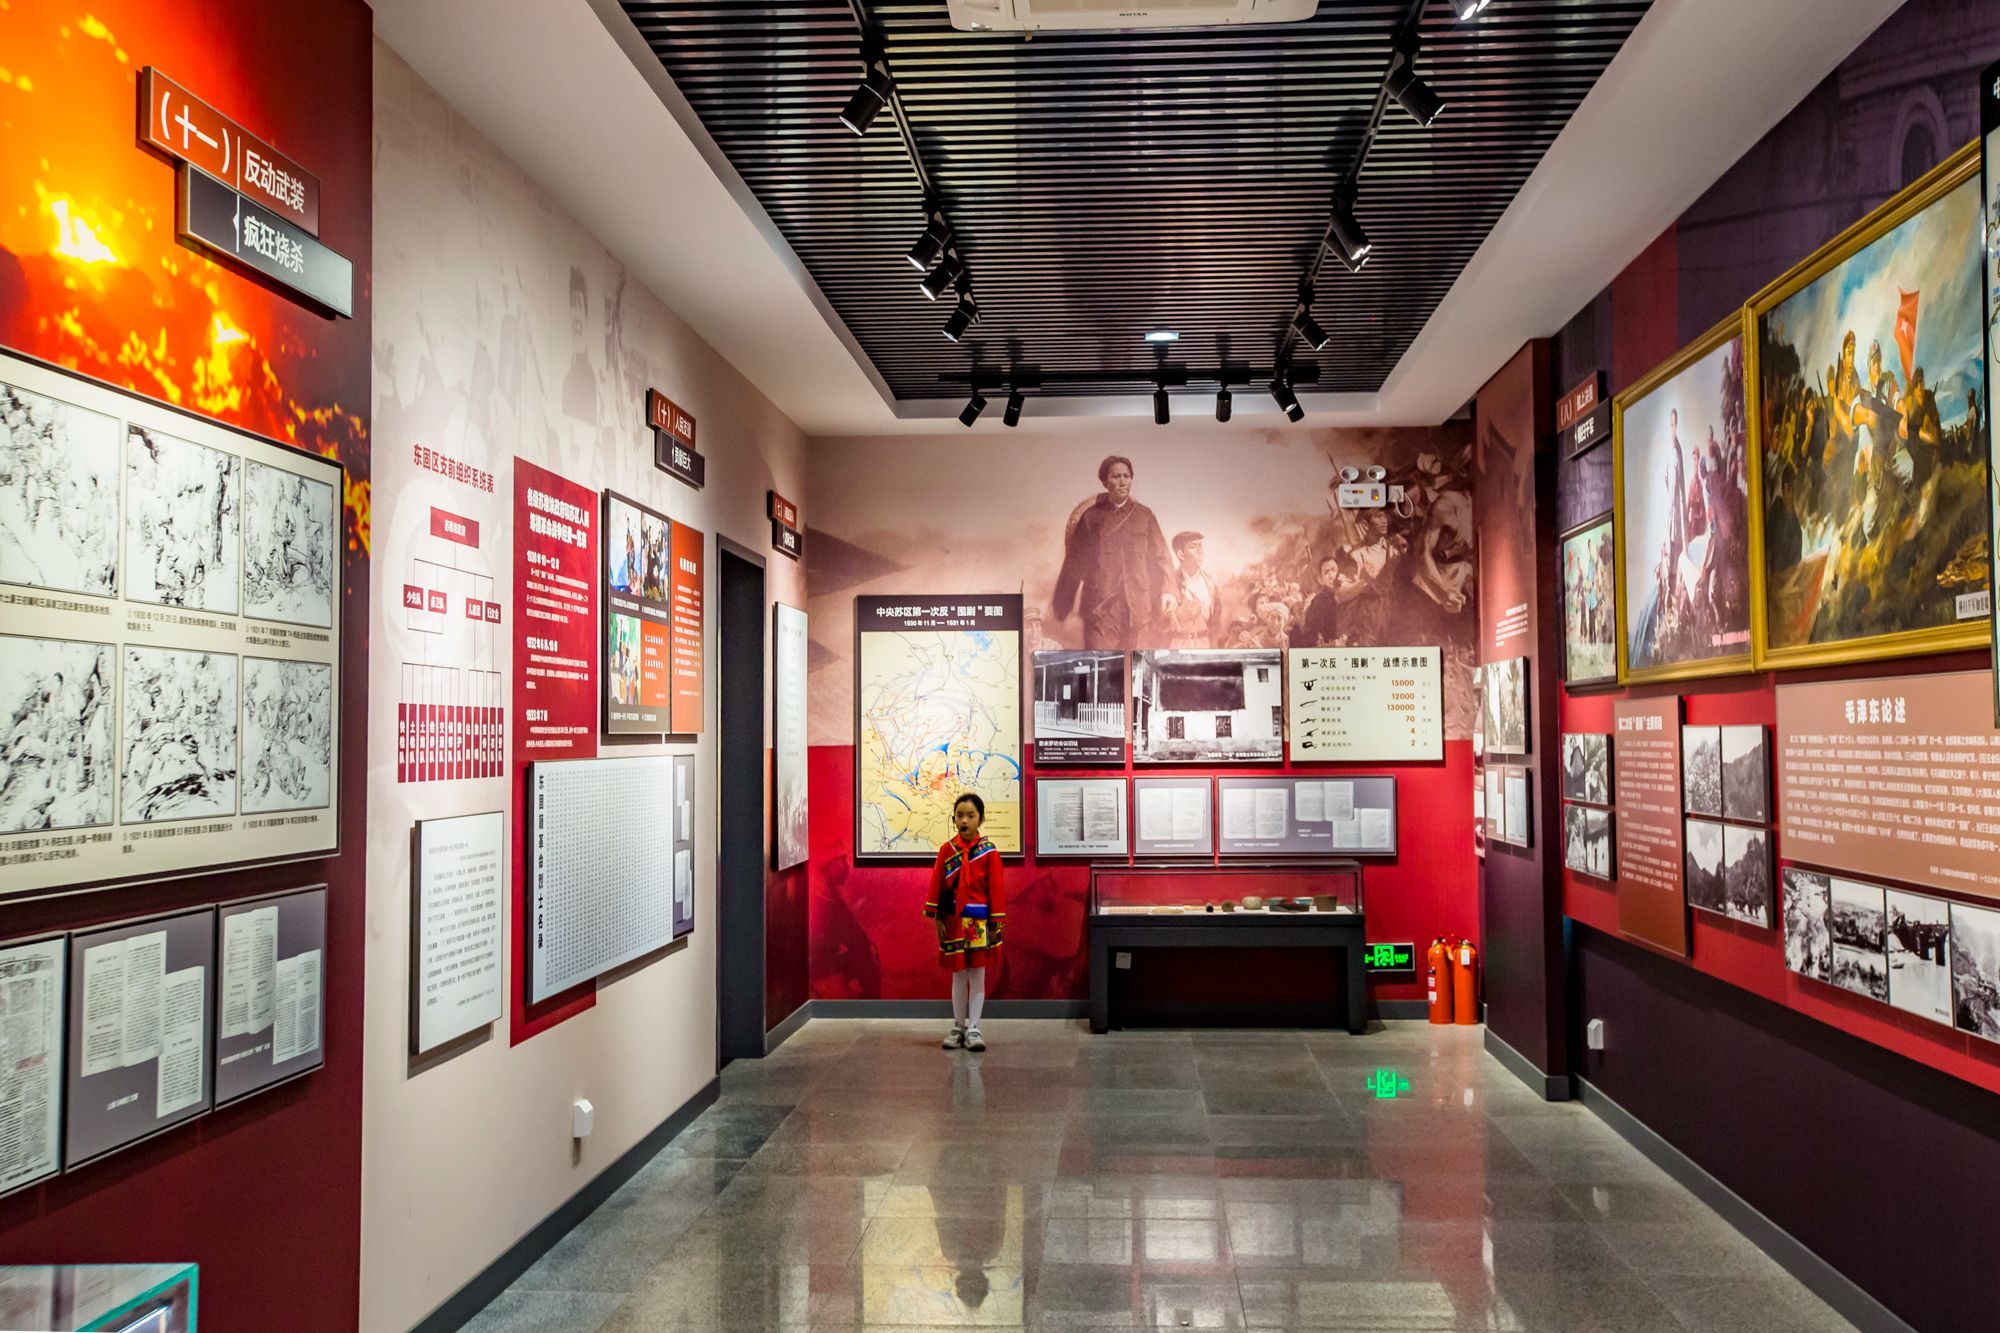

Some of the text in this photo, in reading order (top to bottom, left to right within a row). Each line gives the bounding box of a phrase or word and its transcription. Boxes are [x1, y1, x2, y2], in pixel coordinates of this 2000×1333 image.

[161, 91, 305, 214] （十一） 反动武装
[243, 215, 304, 274] 疯狂烧杀
[657, 399, 671, 428] （十）
[413, 443, 494, 494] 东固区支前组织系统表
[1391, 679, 1415, 687] 15000
[1844, 697, 1906, 724] 毛泽东论述
